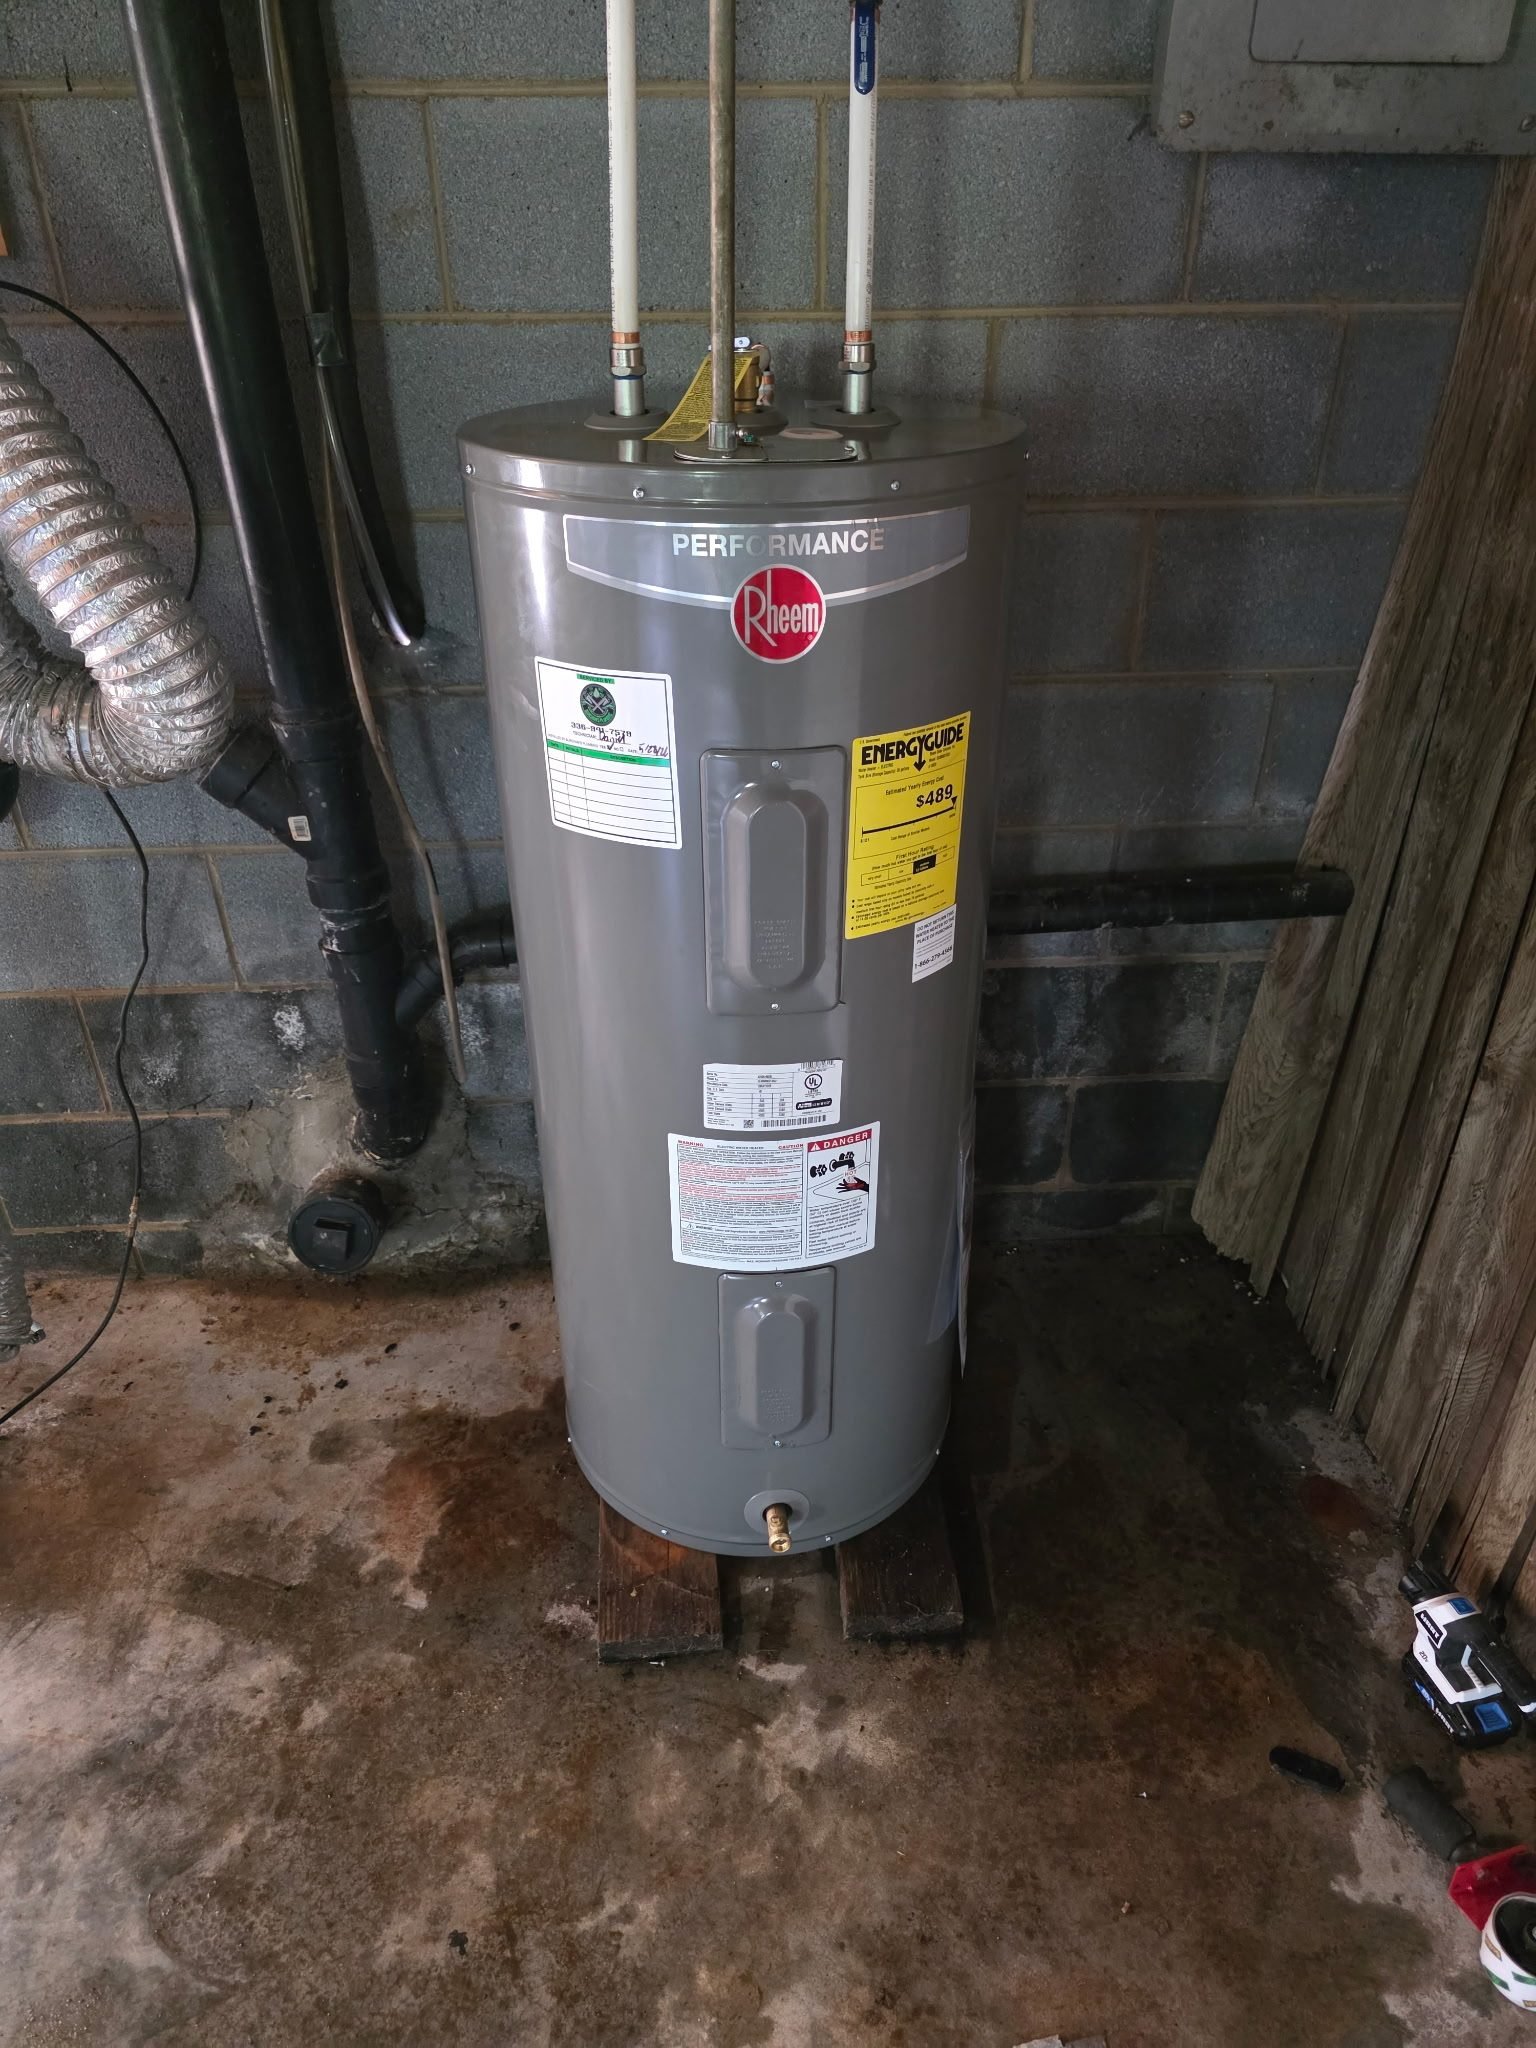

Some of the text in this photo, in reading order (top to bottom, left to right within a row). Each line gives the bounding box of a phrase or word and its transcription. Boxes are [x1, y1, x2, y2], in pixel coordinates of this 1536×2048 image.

[672, 528, 884, 557] PERFORMANCE
[744, 570, 819, 647] Rheem
[862, 722, 964, 768] ENERGYGUIDE
[886, 786, 907, 796] Estimated
[908, 783, 921, 791] Yearly
[922, 778, 936, 786] Energy
[916, 784, 953, 808] $489
[824, 1132, 868, 1148] DANGER
